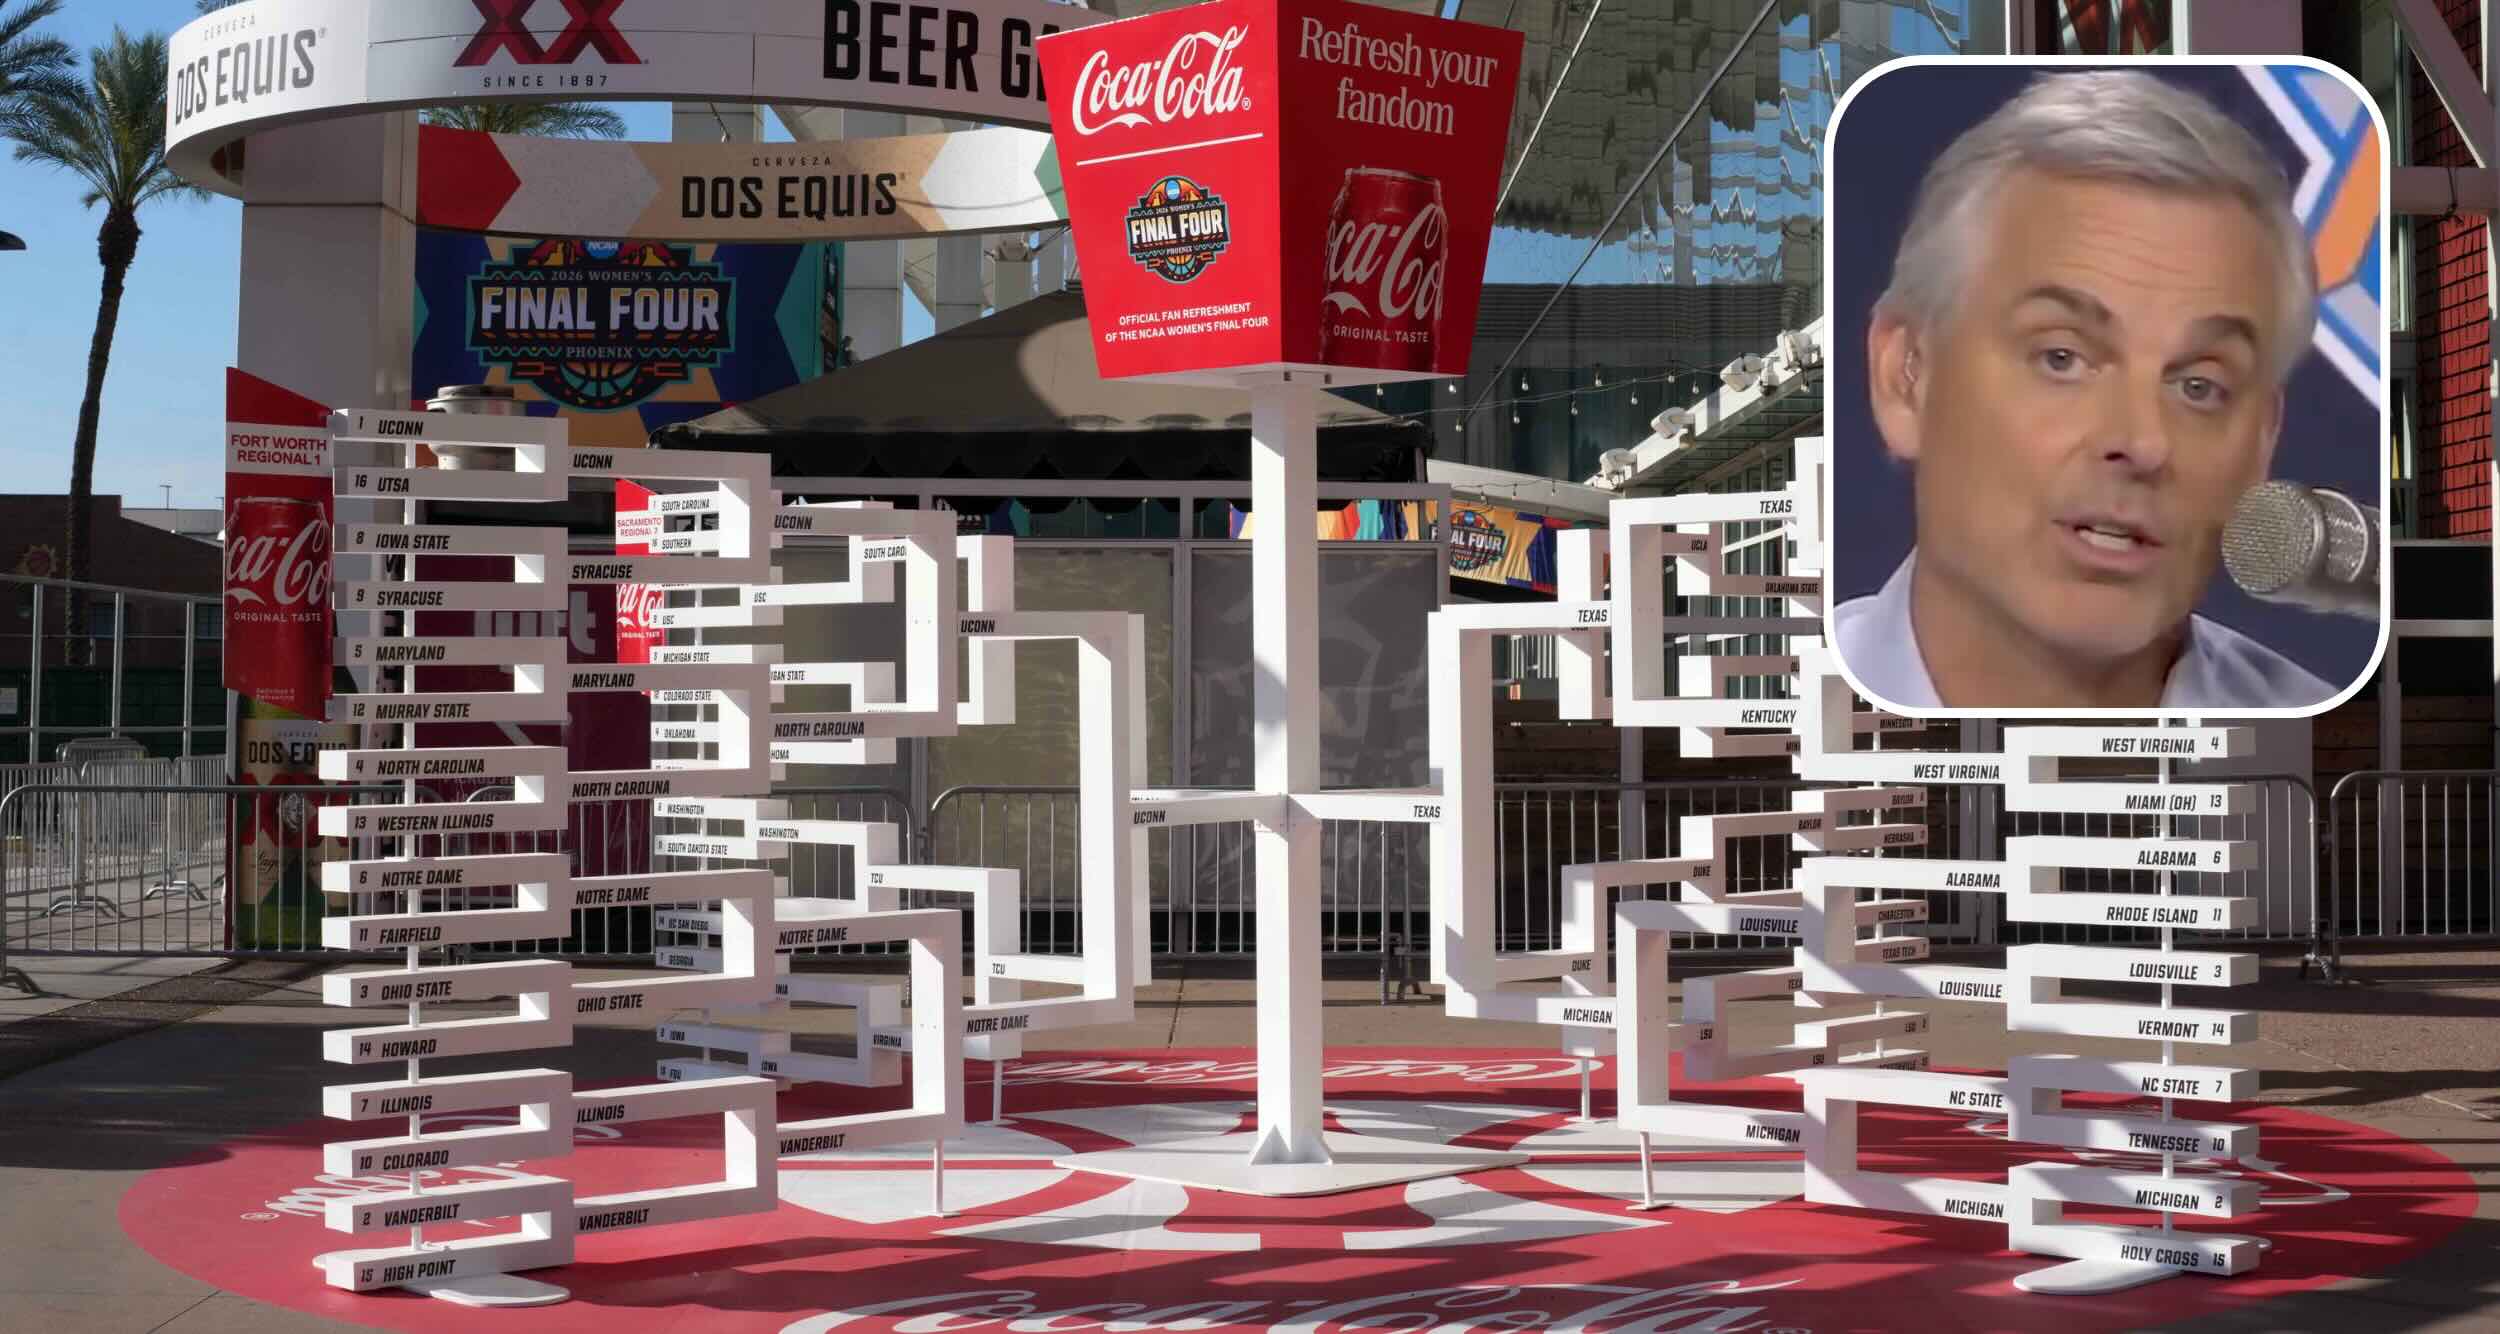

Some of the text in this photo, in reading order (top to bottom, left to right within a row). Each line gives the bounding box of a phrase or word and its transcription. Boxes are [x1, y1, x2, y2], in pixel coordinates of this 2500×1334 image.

[823, 0, 979, 92] BEER
[1300, 16, 1498, 89] Refresh your
[175, 28, 317, 126] DOS EQUIS
[483, 74, 610, 89] SINCE 1897
[1072, 24, 1249, 136] Coca-Cola
[1336, 76, 1454, 136] fandom
[752, 156, 832, 168] CERVEZA
[681, 172, 897, 222] DOS EQUIS
[1130, 209, 1225, 245] FINAL FOUR
[551, 271, 653, 281] 2026 WOMEN'S
[481, 287, 719, 331] FINAL FOUR
[1119, 302, 1251, 326] OFFICIAL FAN REFRESHMENT
[1105, 316, 1268, 343] OF THE NCAA WOMEN'S FINAL FOUR
[1334, 324, 1429, 343] ORIGINAL TASTE
[566, 347, 633, 358] PHOENIX
[378, 419, 424, 436] UCONN
[231, 434, 327, 451] FORT WORTH
[237, 450, 312, 465] REGIONAL
[573, 453, 613, 469] UCONN
[355, 474, 410, 494] 16 UTSA
[661, 500, 681, 511] SOUTH
[682, 498, 710, 510] CAROLINA
[1760, 500, 1792, 514] TEXAS
[774, 514, 813, 530] UCONN
[376, 534, 450, 550] IOWA STATE
[662, 538, 692, 550] SOUTHERN
[1468, 532, 1502, 551] FOUR
[1691, 540, 1708, 551] UCLA
[864, 547, 886, 560] SOUTH
[572, 563, 633, 580] SYRACUSE
[1765, 582, 1818, 594] OKLAHOMA STATE
[377, 590, 444, 607] SYRACUSE
[234, 611, 321, 623] ORIGINAL TASTE
[1577, 608, 1608, 623] TEXAS
[960, 619, 995, 633] UCONN
[376, 645, 446, 662] MARYLAND
[663, 652, 692, 663] MICHIGAN
[693, 652, 710, 663] STATE
[572, 671, 635, 689] MARYLAND
[787, 670, 805, 681] STATE
[663, 690, 694, 702] COLORADO
[695, 690, 712, 701] STATE
[352, 702, 471, 720] 12 MURRAY STATE
[1742, 709, 1797, 724] KENTUCKY
[664, 728, 695, 738] OKLAHOMA
[774, 721, 865, 737] NORTH CAROLINA
[2102, 738, 2196, 754] WEST VIRGINIA
[377, 758, 485, 775] NORTH CAROLINA
[1914, 764, 2000, 780] WEST VIRGINIA
[572, 779, 670, 798] NORTH CAROLINA
[667, 804, 705, 815] WASHINGTON
[1412, 804, 1441, 818] TEXAS
[2125, 794, 2222, 811] MIAMI (OH) 13
[354, 813, 494, 832] 13 WESTERN ILLINOIS
[1134, 810, 1166, 825] UCONN
[759, 828, 799, 840] WASHINGTON
[667, 842, 685, 853] SOUTH
[687, 843, 710, 854] DAKOTA
[711, 845, 728, 855] STATE
[2138, 851, 2197, 866] ALABAMA
[381, 869, 464, 886] NOTRE DAME
[1693, 865, 1711, 877] DUKE
[1946, 872, 2001, 888] ALABAMA
[576, 886, 650, 905] NOTRE DAME
[2106, 906, 2222, 924] RHODE ISLAND 11
[1740, 917, 1798, 934] LOUISVILLE
[379, 926, 441, 943] FAIRFIELD
[779, 927, 848, 946] NOTRE DAME
[992, 963, 1005, 975] TCU
[1572, 960, 1591, 971] DUKE
[2129, 963, 2198, 980] LOUISVILLE
[381, 981, 453, 1001] OHIO STATE
[1939, 981, 2003, 998] LOUISVILLE
[577, 993, 643, 1013] OHIO STATE
[966, 1015, 1029, 1033] NOTRE DAME
[1563, 1008, 1613, 1024] MICHIGAN
[670, 1031, 685, 1041] IOWA
[1700, 1029, 1712, 1041] LSU
[2138, 1020, 2224, 1038] VERMONT 14
[359, 1039, 437, 1058] 14 HOWARD
[873, 1034, 902, 1047] VIRGINIA
[761, 1061, 778, 1072] IOWA
[1813, 1055, 1825, 1065] LSU
[2141, 1077, 2199, 1095] NC STATE
[380, 1095, 433, 1113] ILLINOIS
[1949, 1090, 2002, 1108] NC STATE
[576, 1104, 625, 1123] ILLINOIS
[1746, 1125, 1800, 1143] MICHIGAN
[780, 1133, 845, 1154] VANDERBILT
[2128, 1133, 2225, 1153] TENNESSEE 10
[359, 1150, 449, 1170] 10 COLORADO
[1945, 1198, 2004, 1218] MICHIGAN
[2136, 1190, 2199, 1210] MICHIGAN
[384, 1204, 460, 1226] VANDERBILT
[579, 1208, 649, 1231] VANDERBILT
[2121, 1244, 2225, 1267] HOLY CROSS 15
[361, 1260, 456, 1283] 15 HIGH POINT
